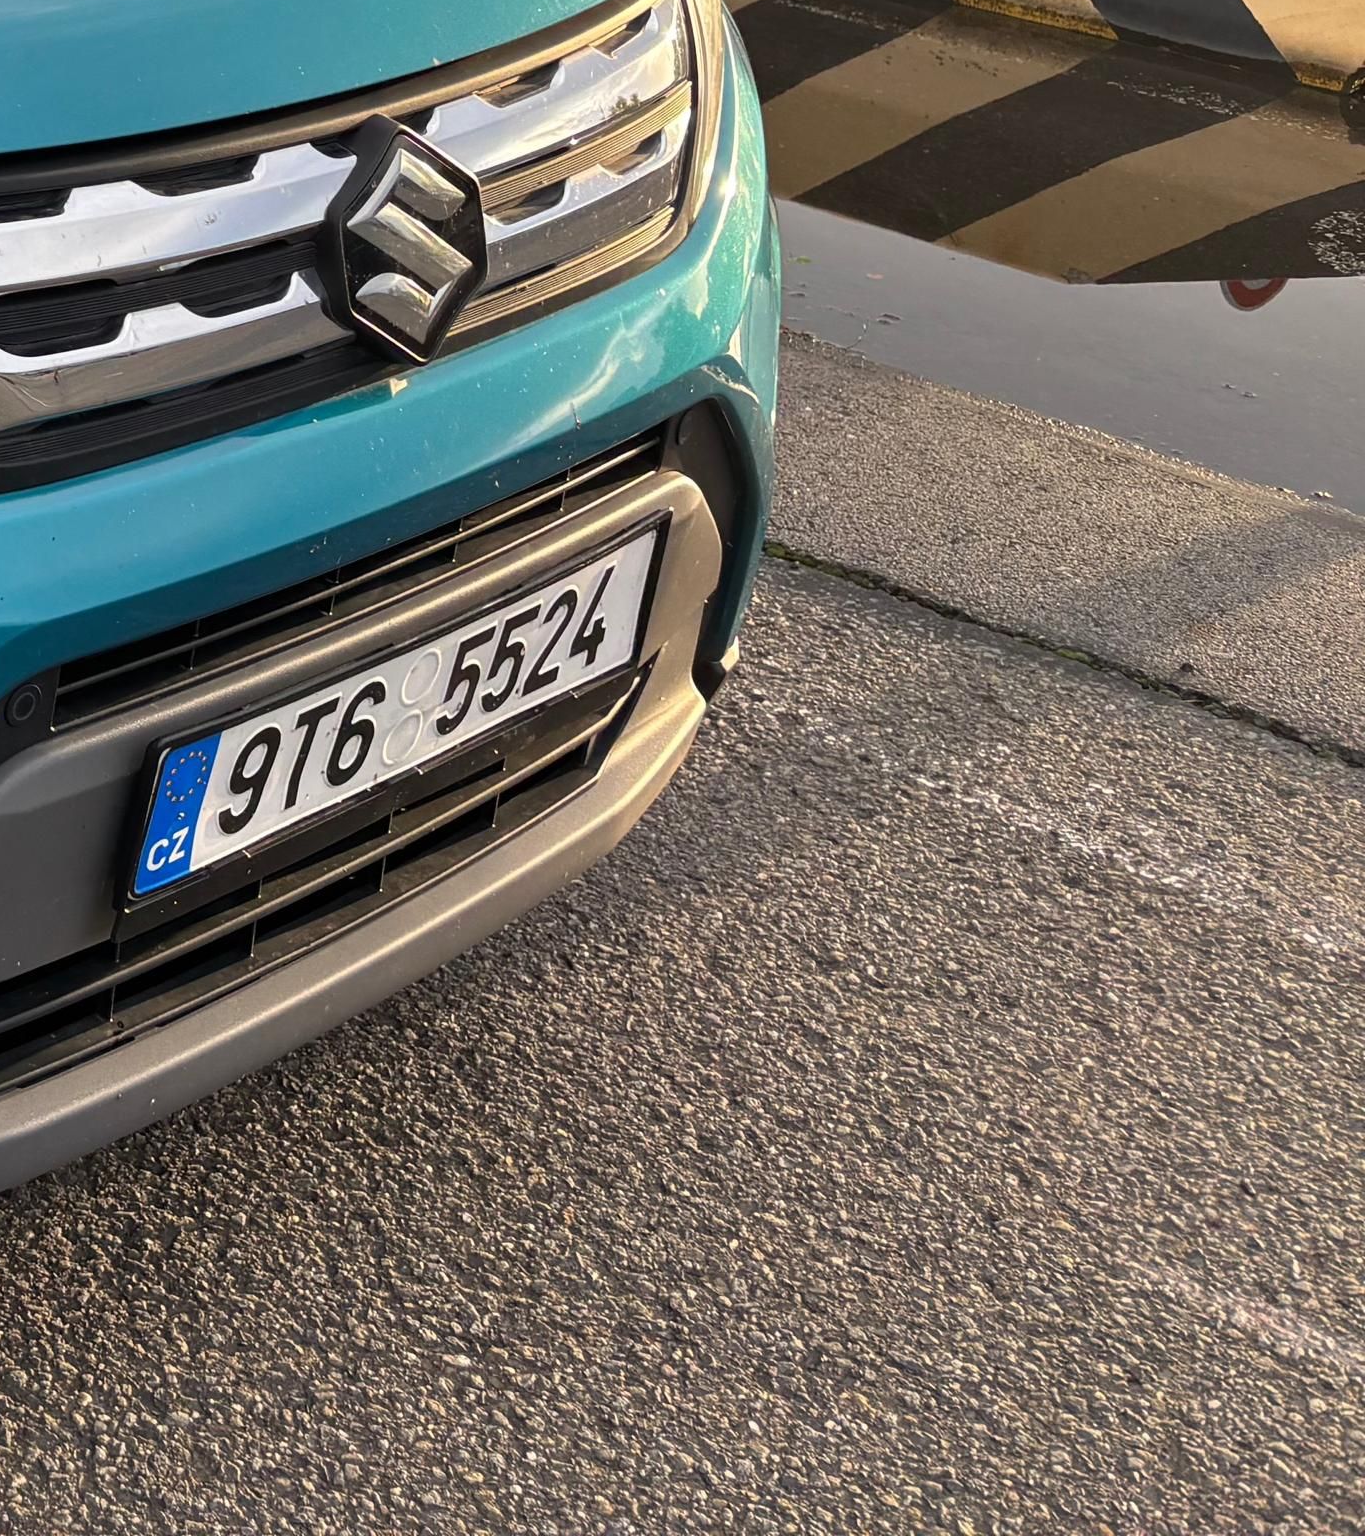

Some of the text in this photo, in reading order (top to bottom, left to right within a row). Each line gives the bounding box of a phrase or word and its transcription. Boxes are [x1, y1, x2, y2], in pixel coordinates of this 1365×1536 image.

[217, 566, 618, 836] 9T6 5524
[146, 826, 187, 873] CZ
